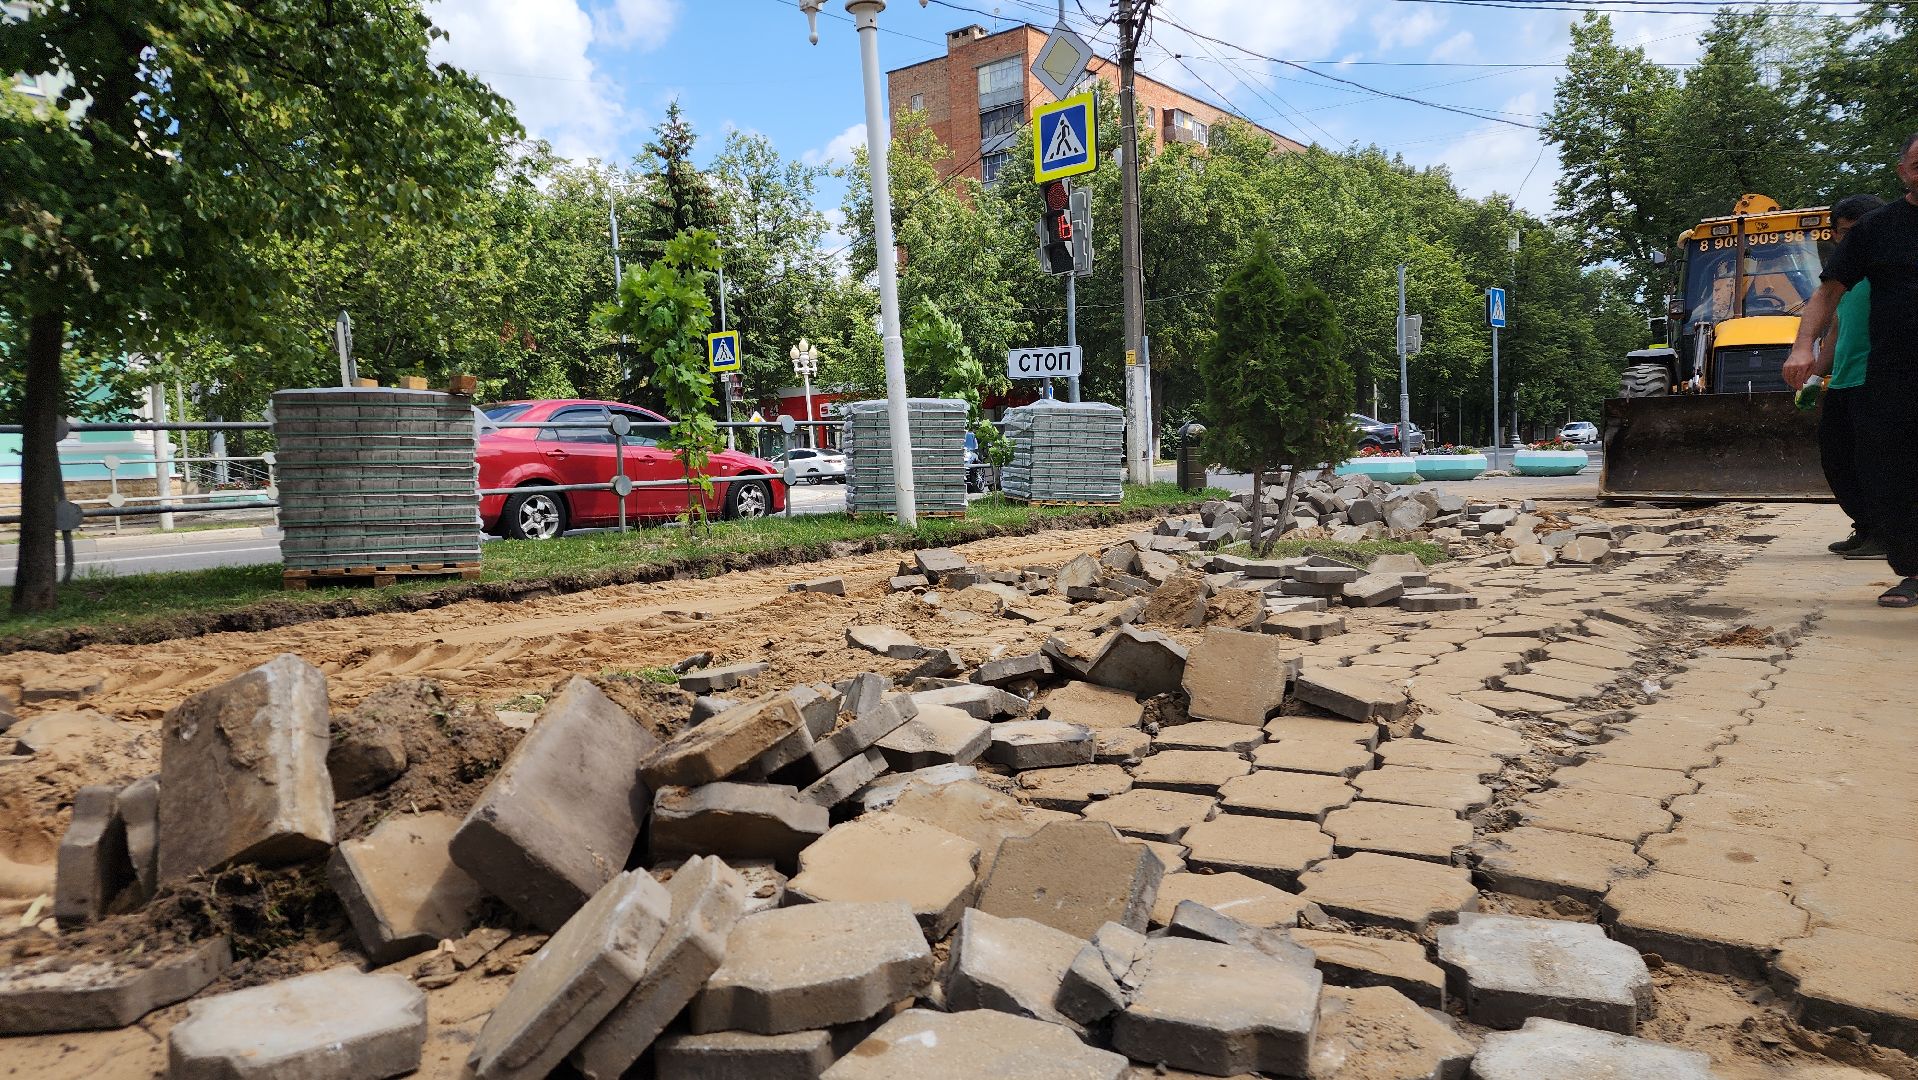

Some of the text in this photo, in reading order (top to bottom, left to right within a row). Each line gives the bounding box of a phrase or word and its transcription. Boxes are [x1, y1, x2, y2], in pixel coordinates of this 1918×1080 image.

[1699, 240, 1709, 252] 8
[1748, 232, 1779, 246] 909
[1810, 229, 1832, 241] 96
[1018, 352, 1071, 372] СТОП
